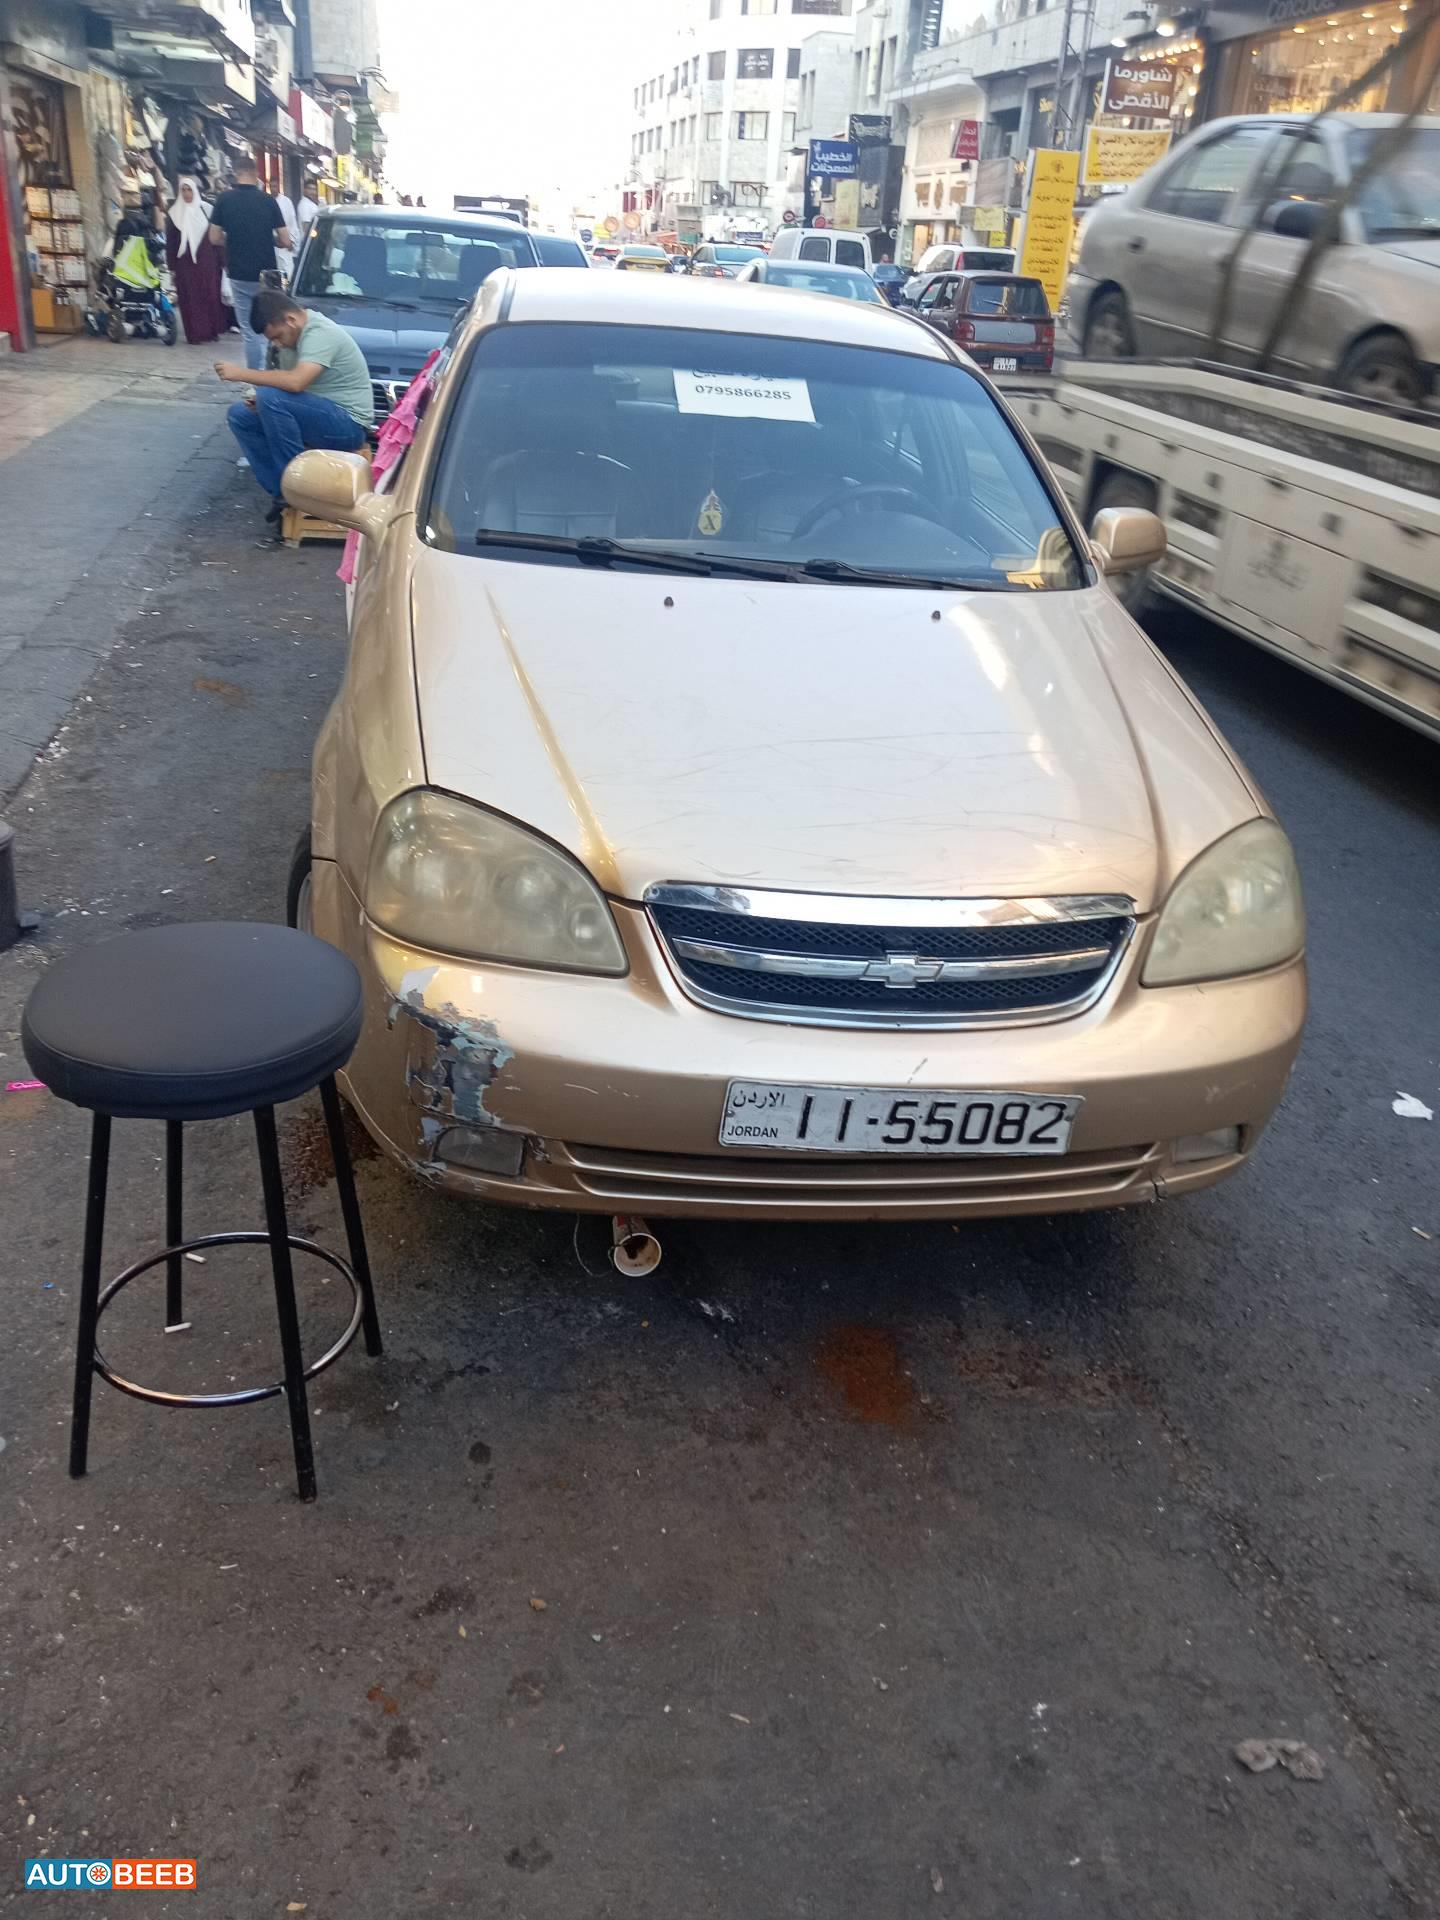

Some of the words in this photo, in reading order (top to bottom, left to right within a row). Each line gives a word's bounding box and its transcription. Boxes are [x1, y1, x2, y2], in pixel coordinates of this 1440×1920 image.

[1114, 65, 1173, 83] شاورما
[1108, 91, 1170, 110] الأقصى
[815, 152, 853, 163] الخطيب
[695, 384, 792, 400] 0795866285
[727, 1125, 779, 1138] JORDAN
